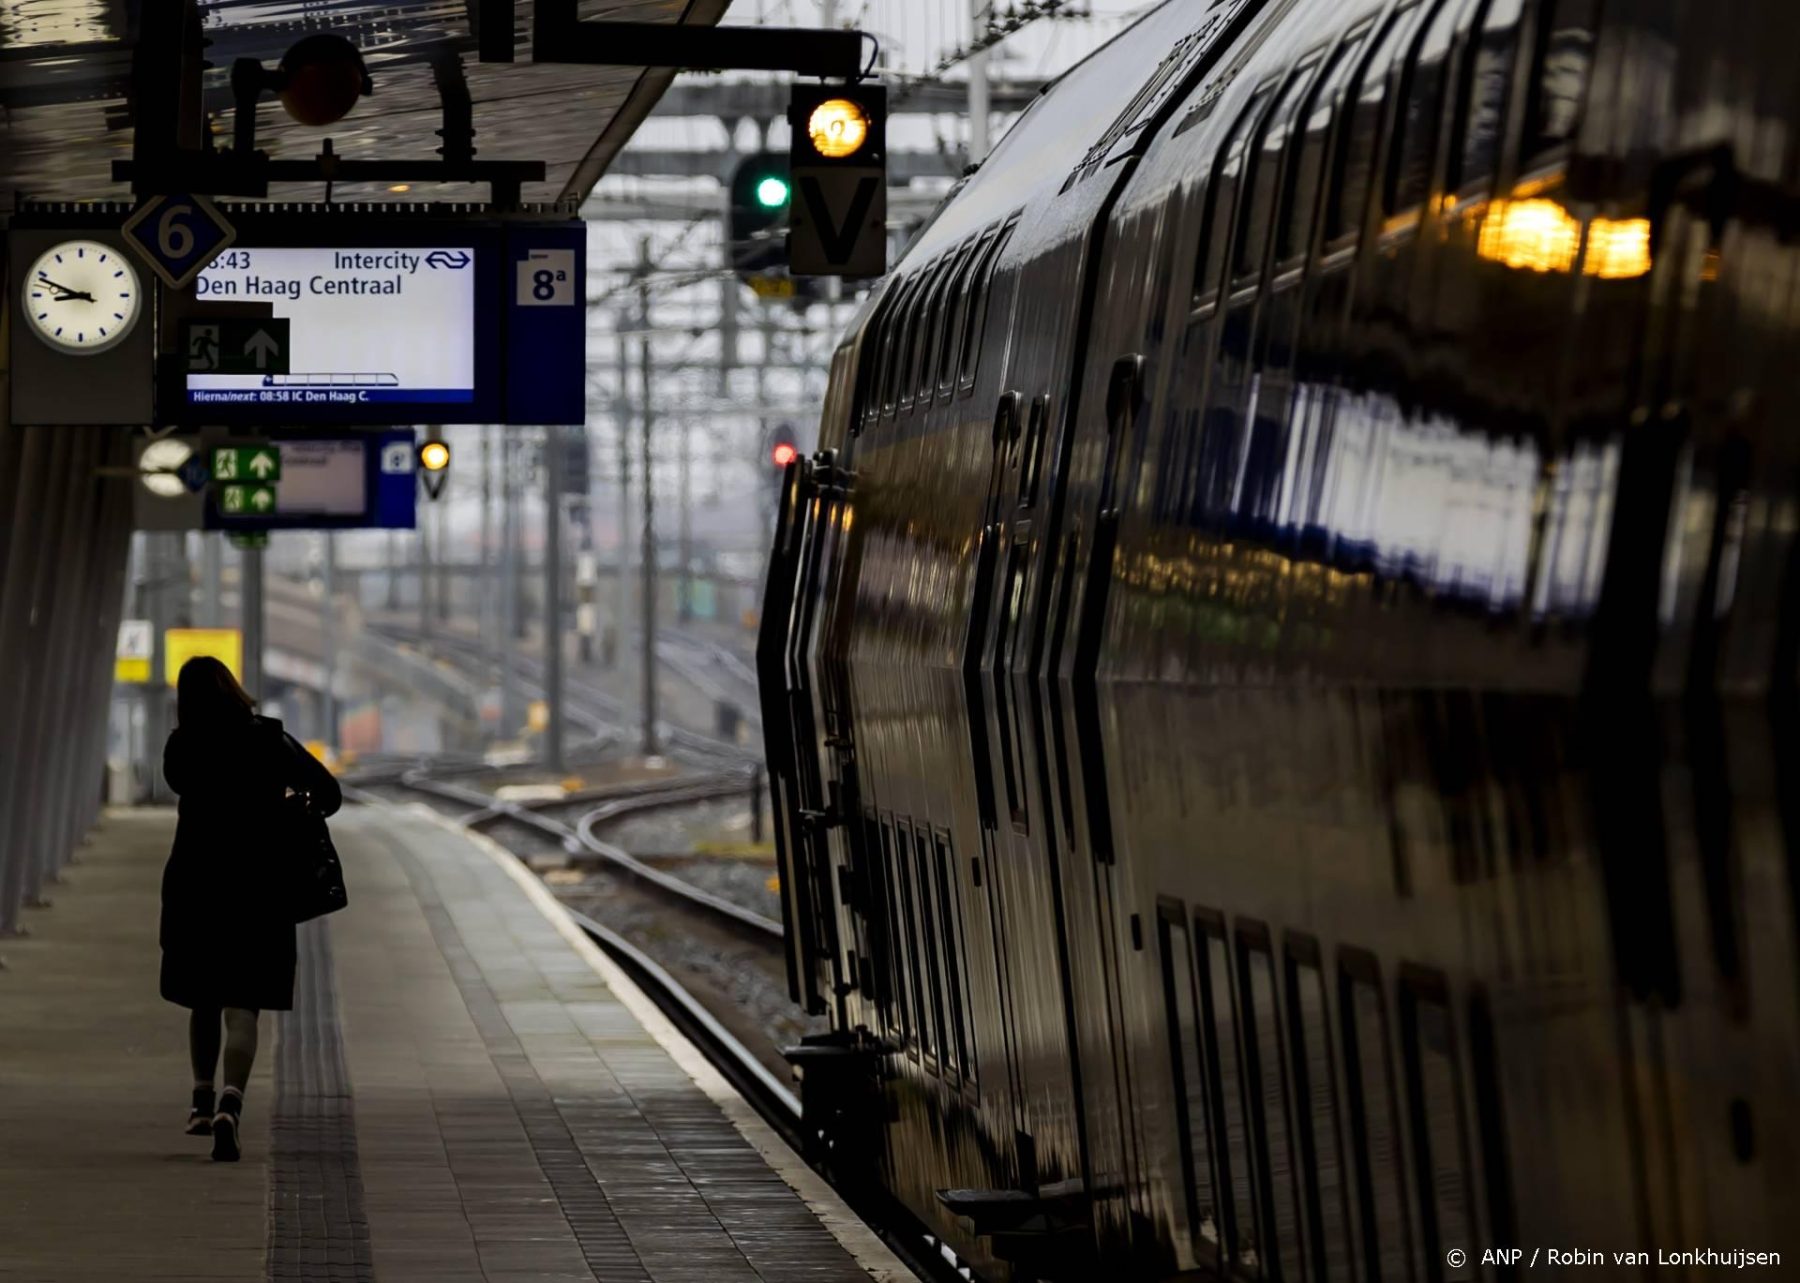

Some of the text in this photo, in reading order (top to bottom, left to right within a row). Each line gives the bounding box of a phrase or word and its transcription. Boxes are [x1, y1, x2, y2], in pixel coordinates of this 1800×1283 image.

[158, 205, 195, 259] 6
[798, 176, 880, 265] V
[335, 251, 420, 274] Intercity
[197, 274, 402, 300] Den Haag Centraal
[193, 391, 369, 404] Hierna/next: 08:58 IC Den Haag C.
